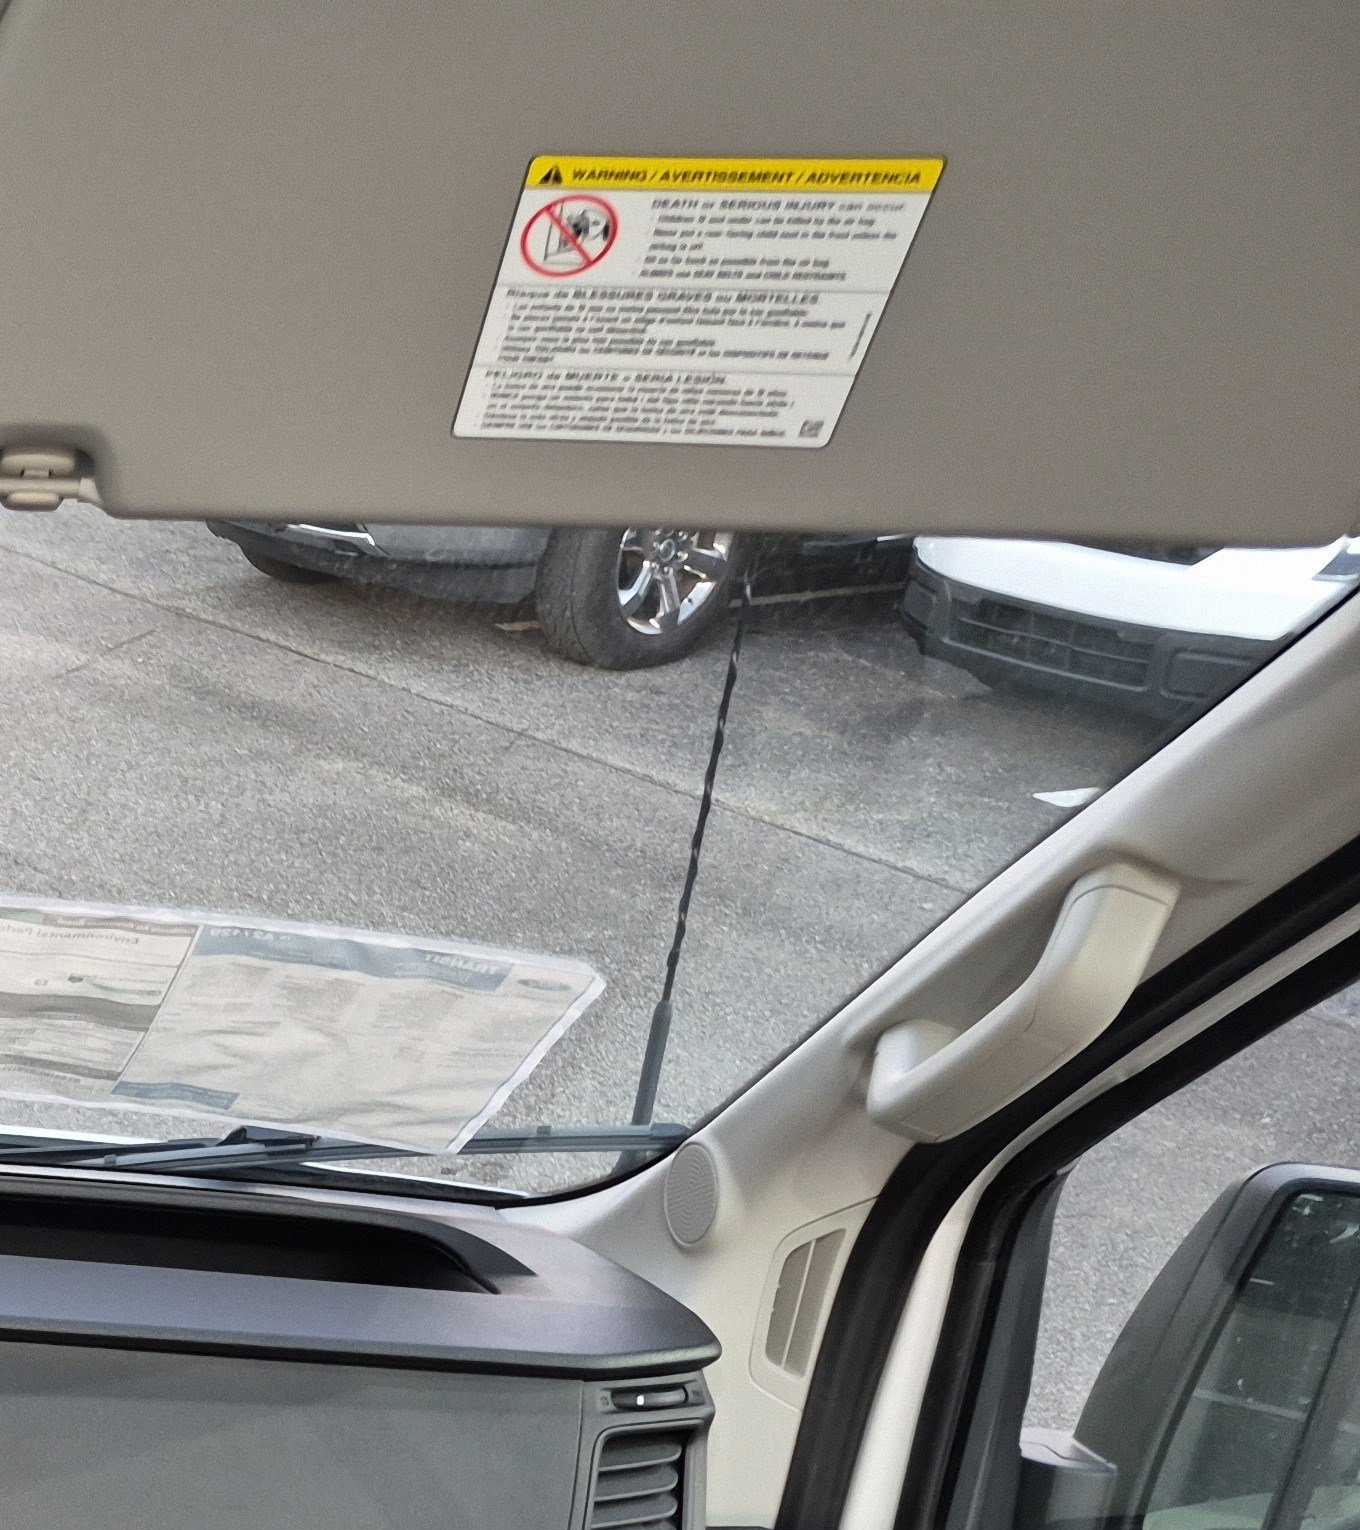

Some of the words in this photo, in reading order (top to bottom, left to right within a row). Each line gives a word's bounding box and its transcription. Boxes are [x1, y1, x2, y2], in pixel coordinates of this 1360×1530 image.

[570, 169, 649, 182] WARNING
[658, 169, 794, 183] AVERTISSEMENT
[804, 171, 923, 185] ADVERTENCIA
